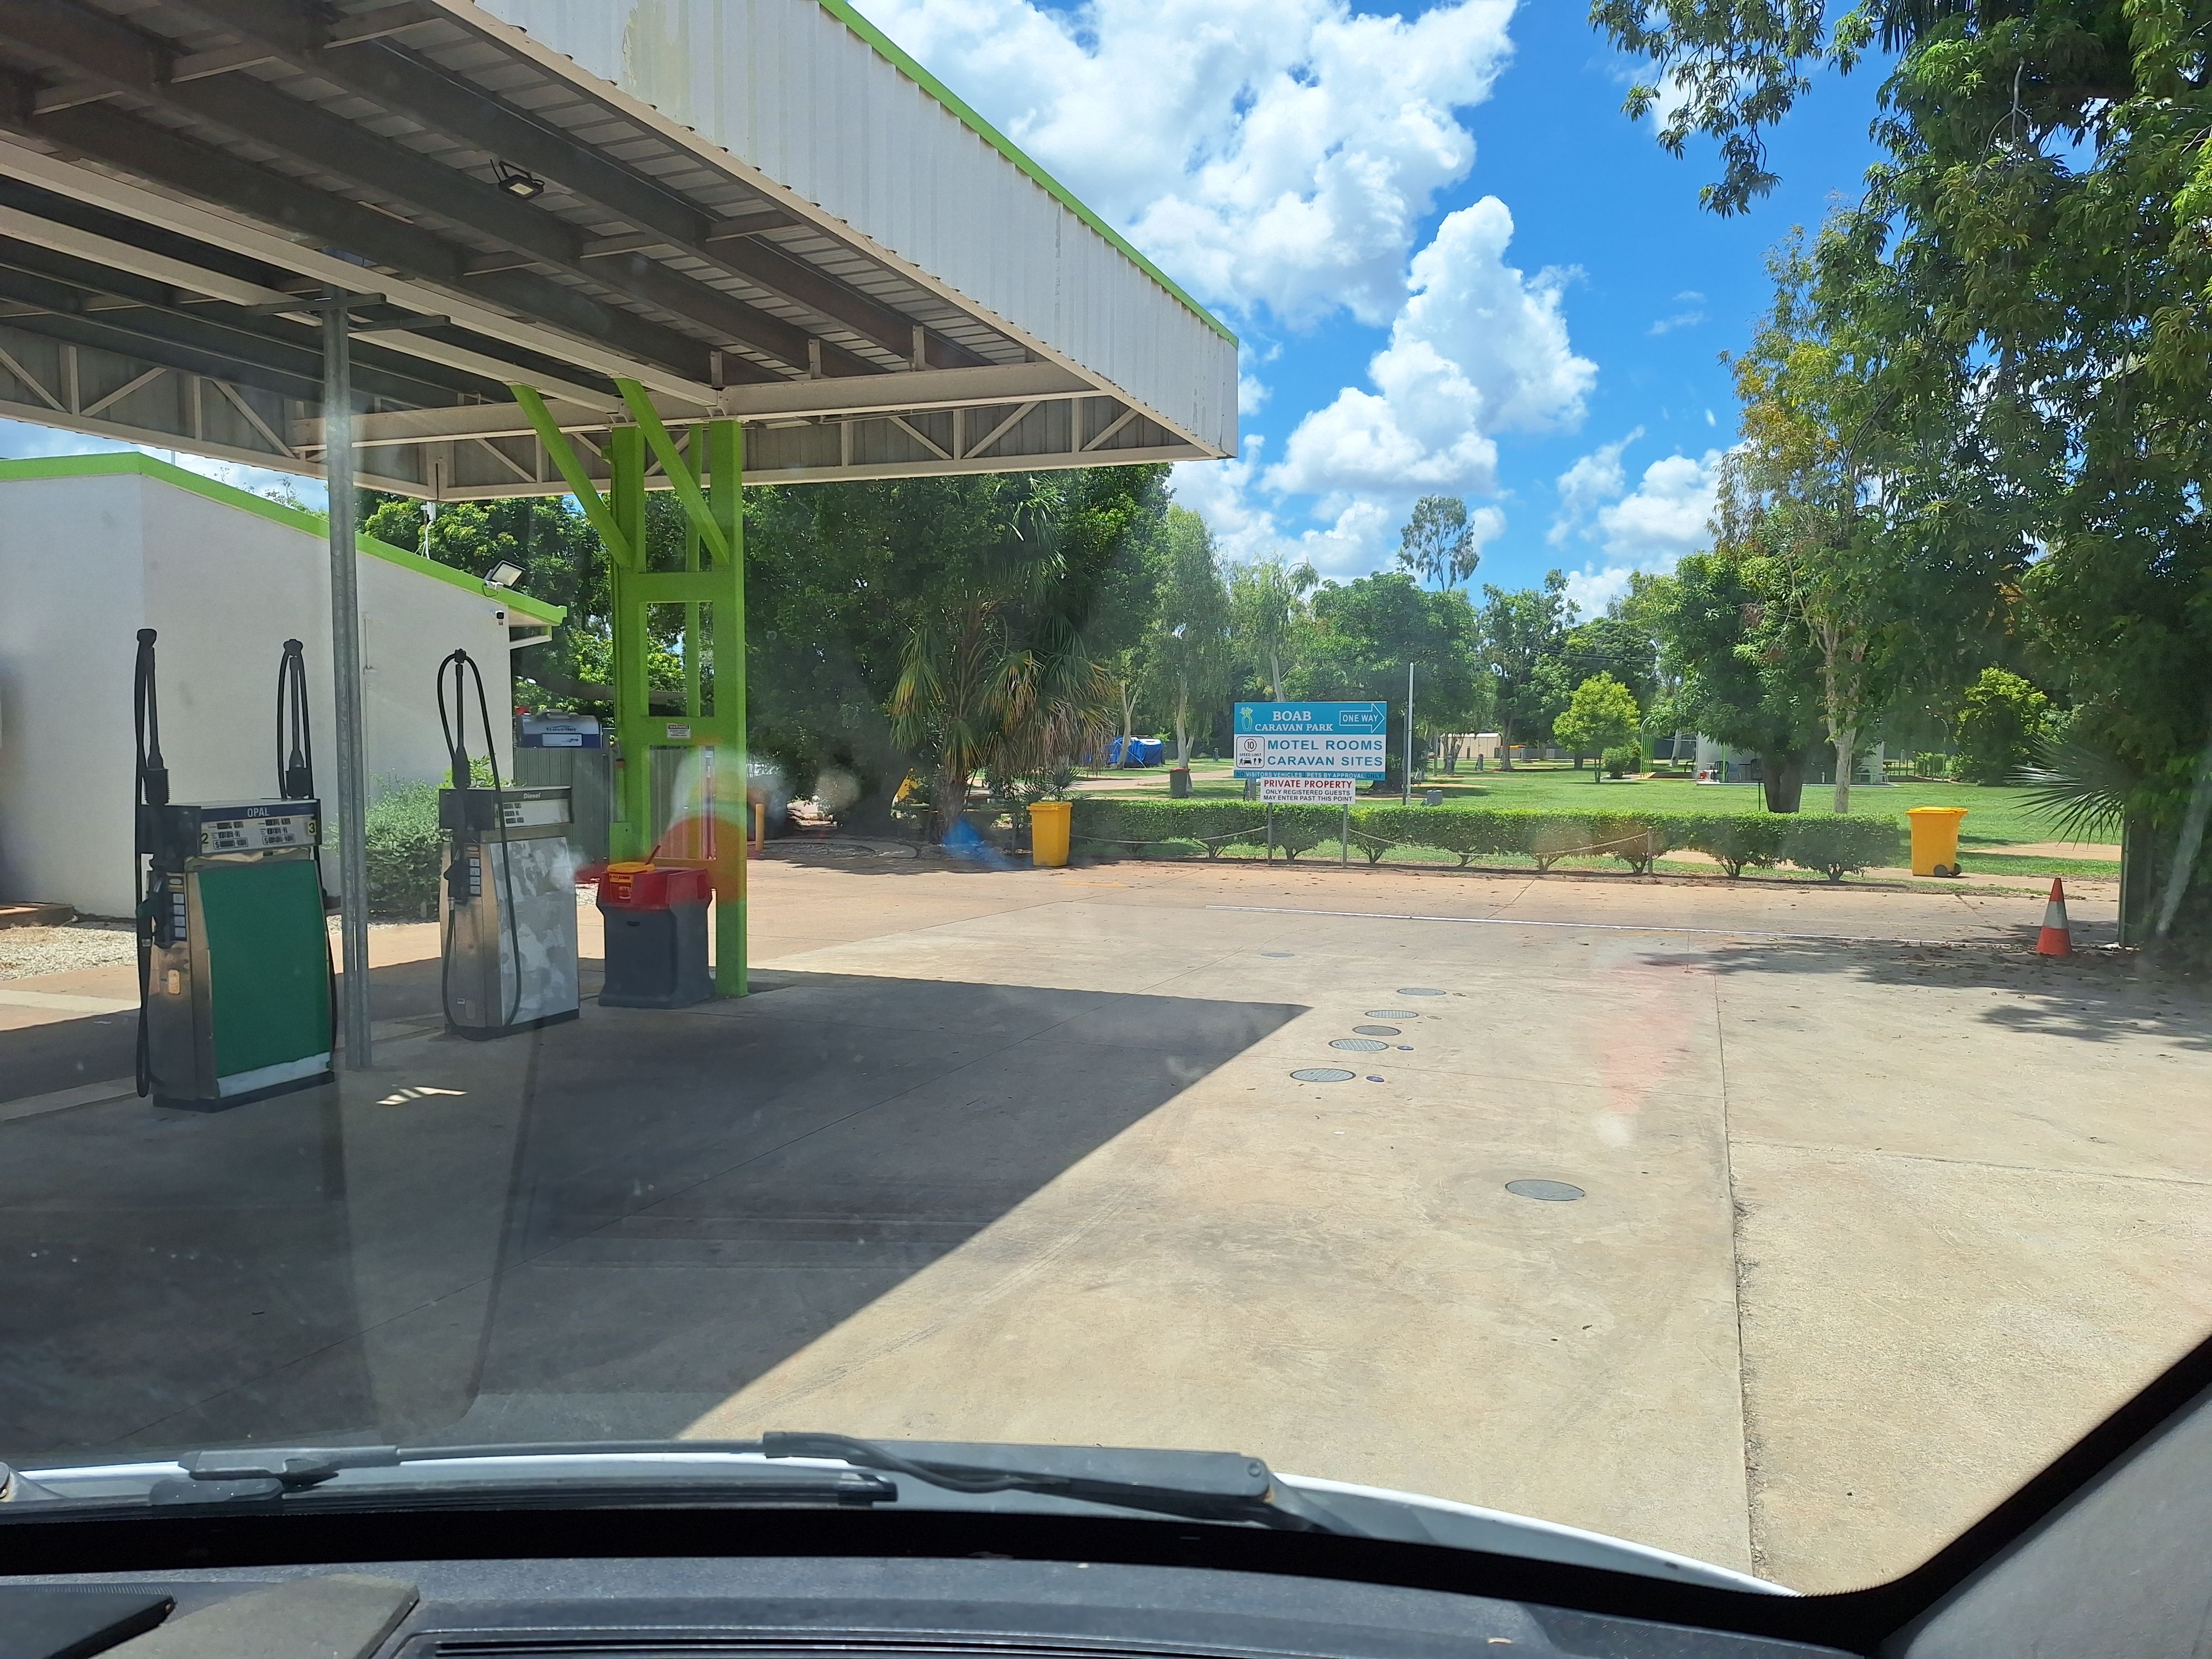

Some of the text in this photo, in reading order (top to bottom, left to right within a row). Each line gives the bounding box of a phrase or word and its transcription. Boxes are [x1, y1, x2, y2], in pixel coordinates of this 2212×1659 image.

[1272, 711, 1312, 721] BOAB
[1247, 741, 1254, 749] 10
[1267, 740, 1383, 750] MOTEL ROOMS
[1267, 756, 1383, 766] CARAVAN SITES
[1305, 780, 1352, 789] PROPERTY
[247, 807, 270, 817] OPAL
[309, 823, 315, 833] 3
[201, 833, 209, 844] 2
